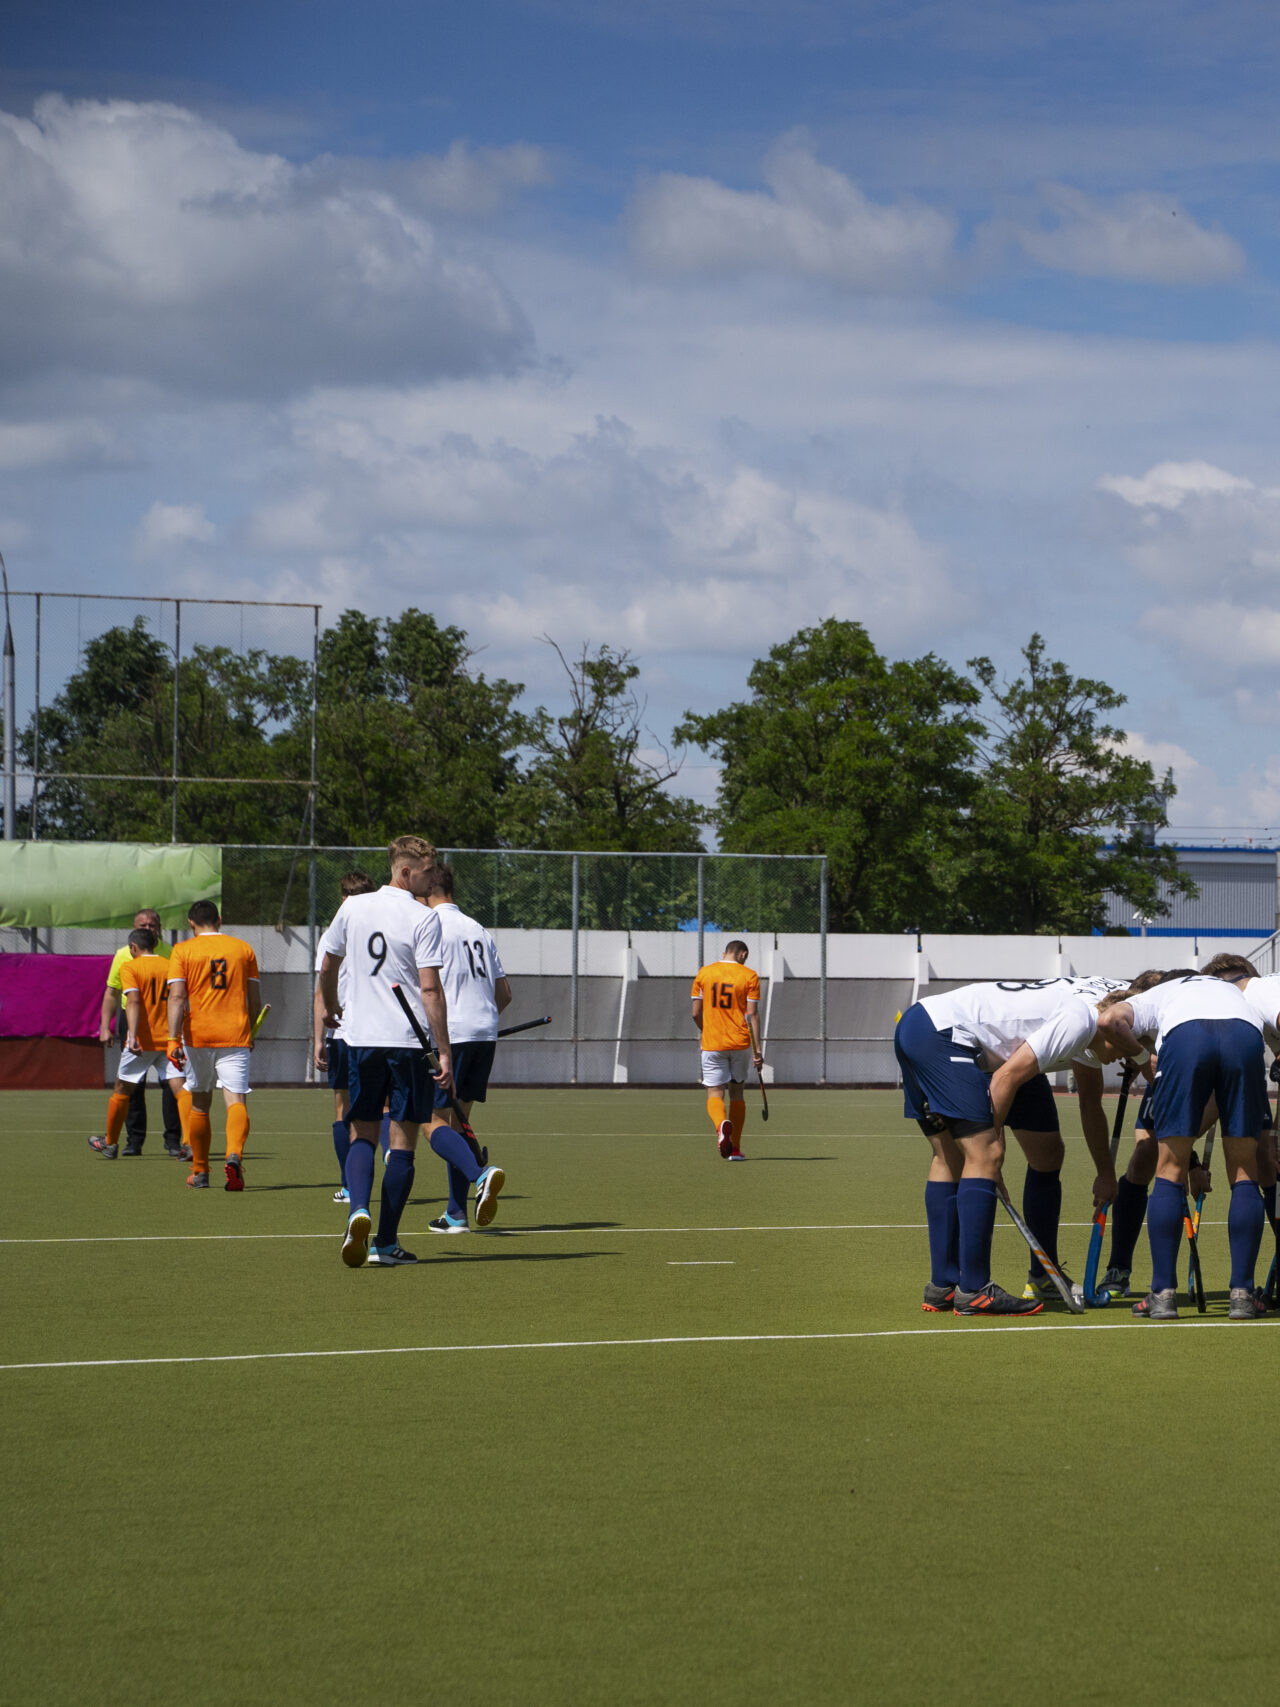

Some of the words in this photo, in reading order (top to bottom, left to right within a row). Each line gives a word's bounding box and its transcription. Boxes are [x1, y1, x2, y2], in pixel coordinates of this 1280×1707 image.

[367, 931, 387, 976] 9
[463, 940, 486, 978] 13
[211, 958, 226, 989] 8
[712, 983, 733, 1009] 15
